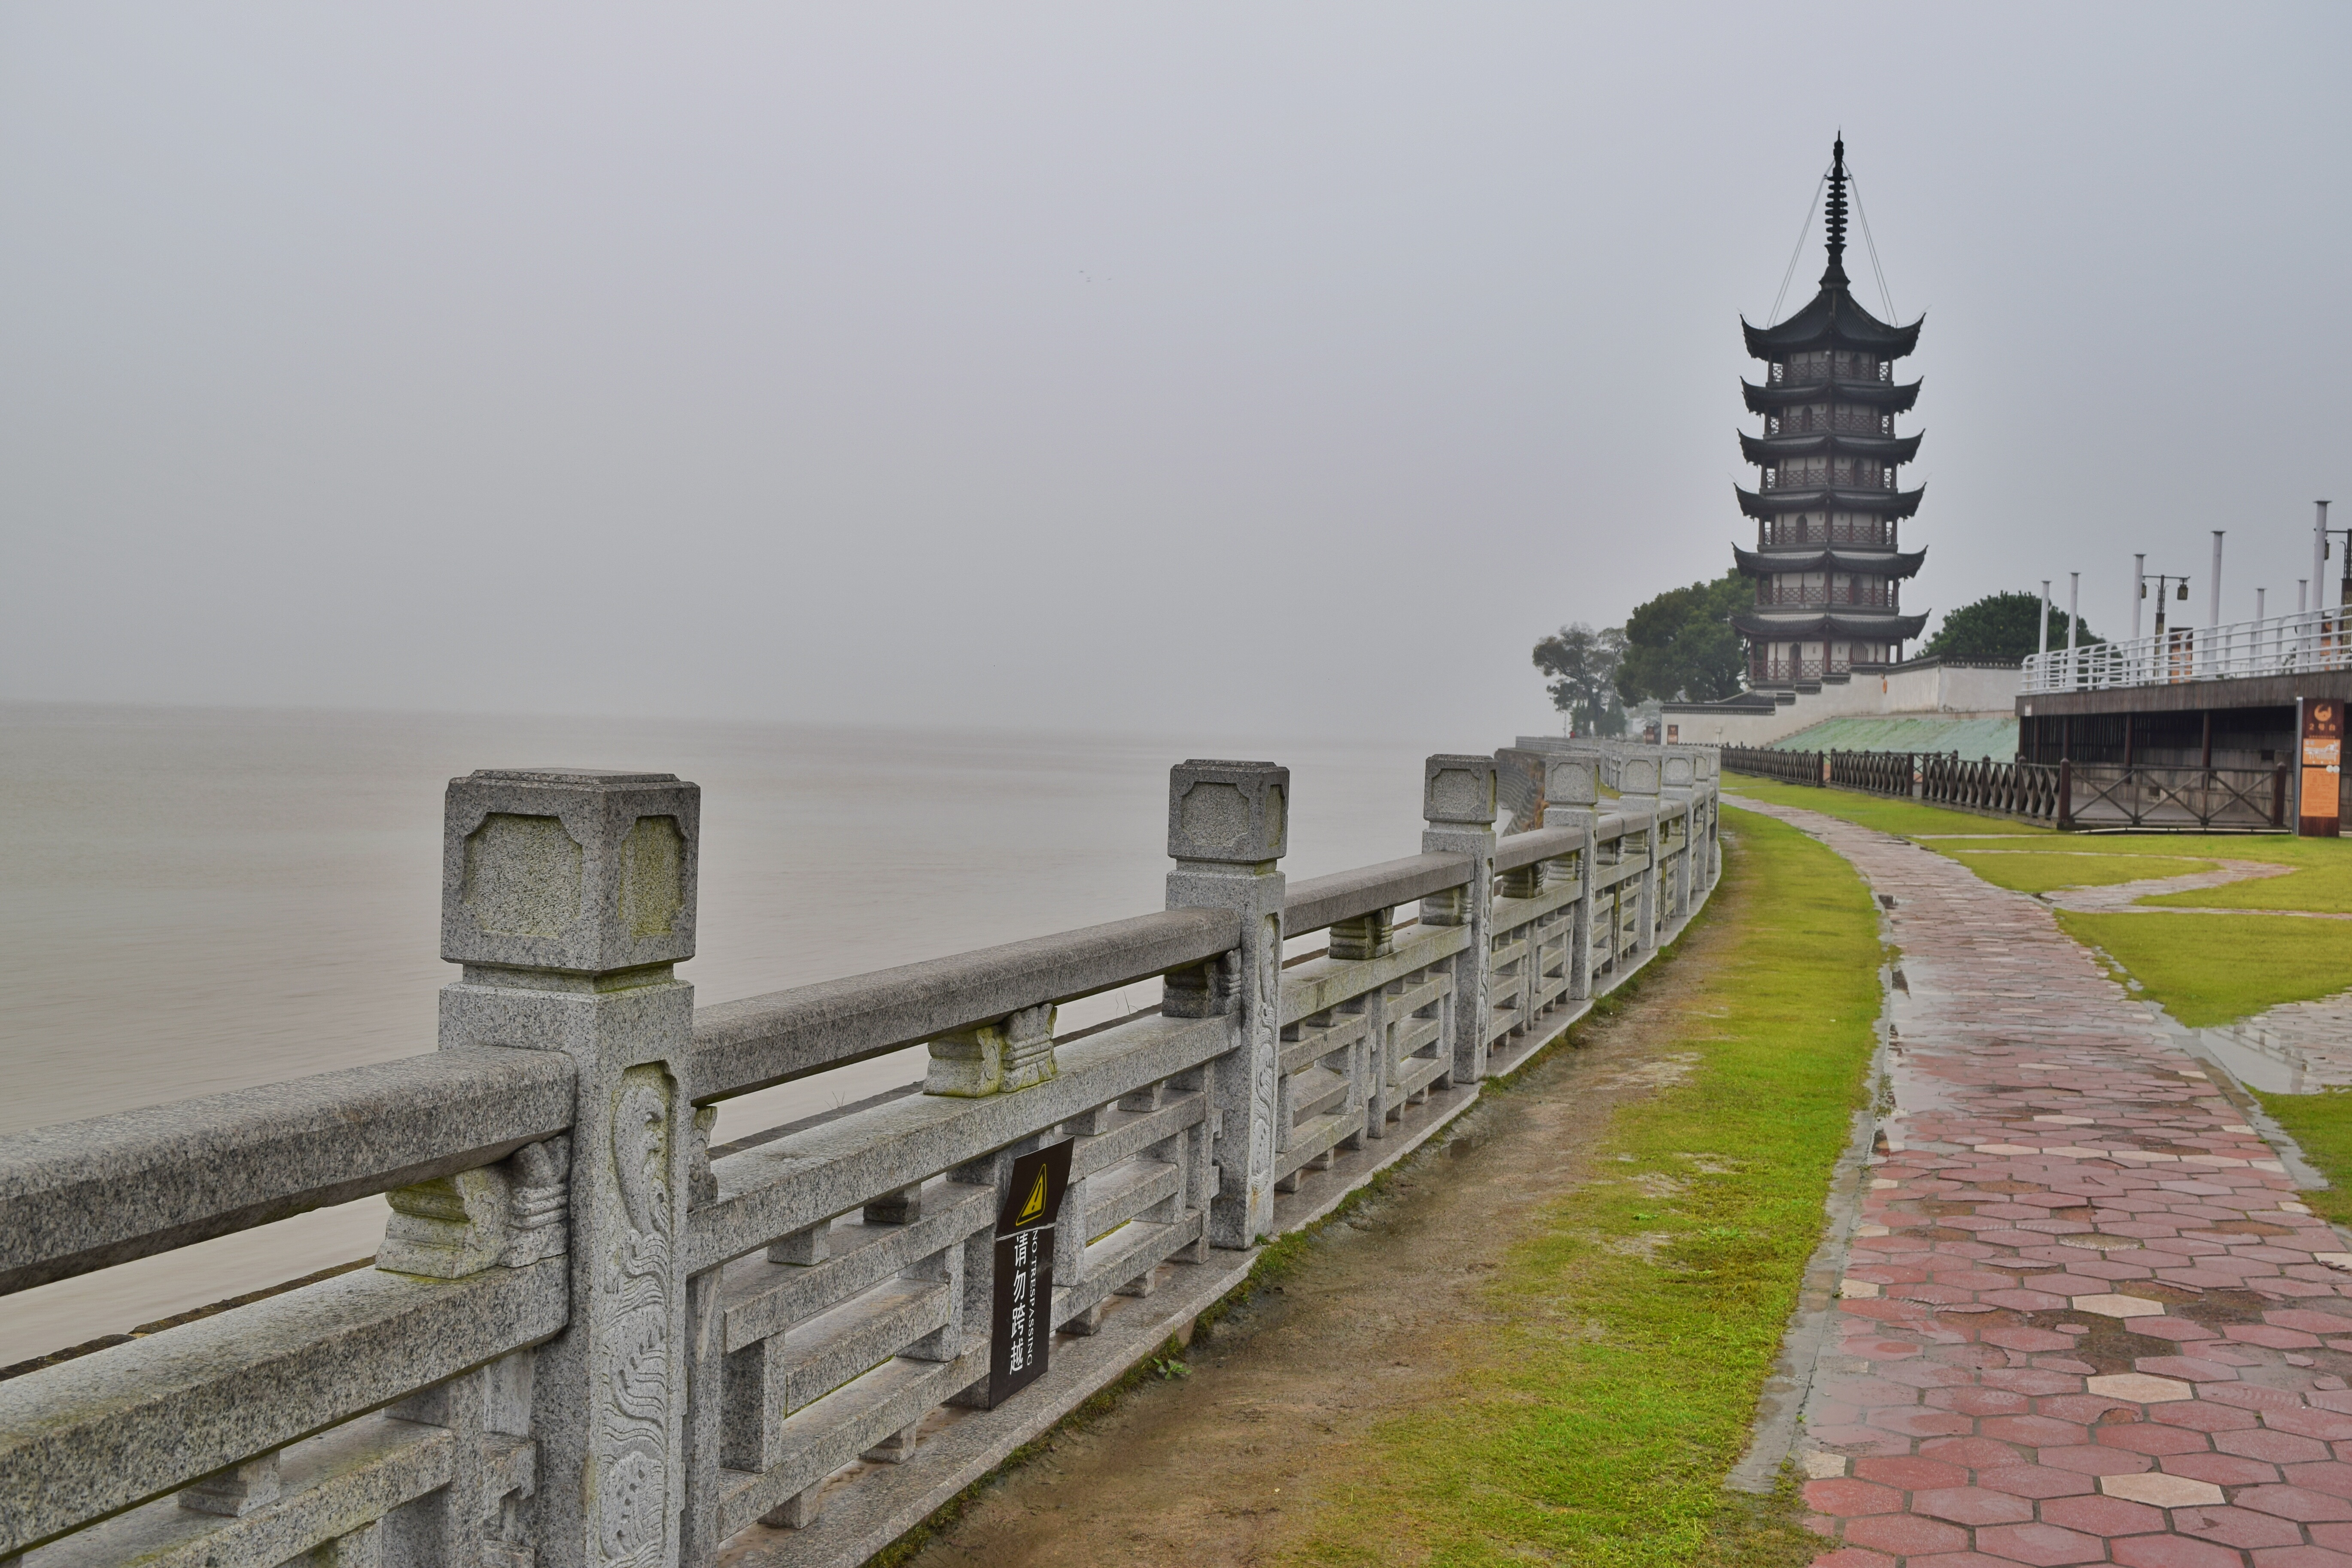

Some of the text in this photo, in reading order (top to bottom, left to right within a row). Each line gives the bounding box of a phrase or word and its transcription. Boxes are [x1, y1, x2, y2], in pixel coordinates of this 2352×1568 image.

[1010, 1232, 1028, 1375] 请勿跨越
[1027, 1230, 1038, 1366] NO TRESPASSING
